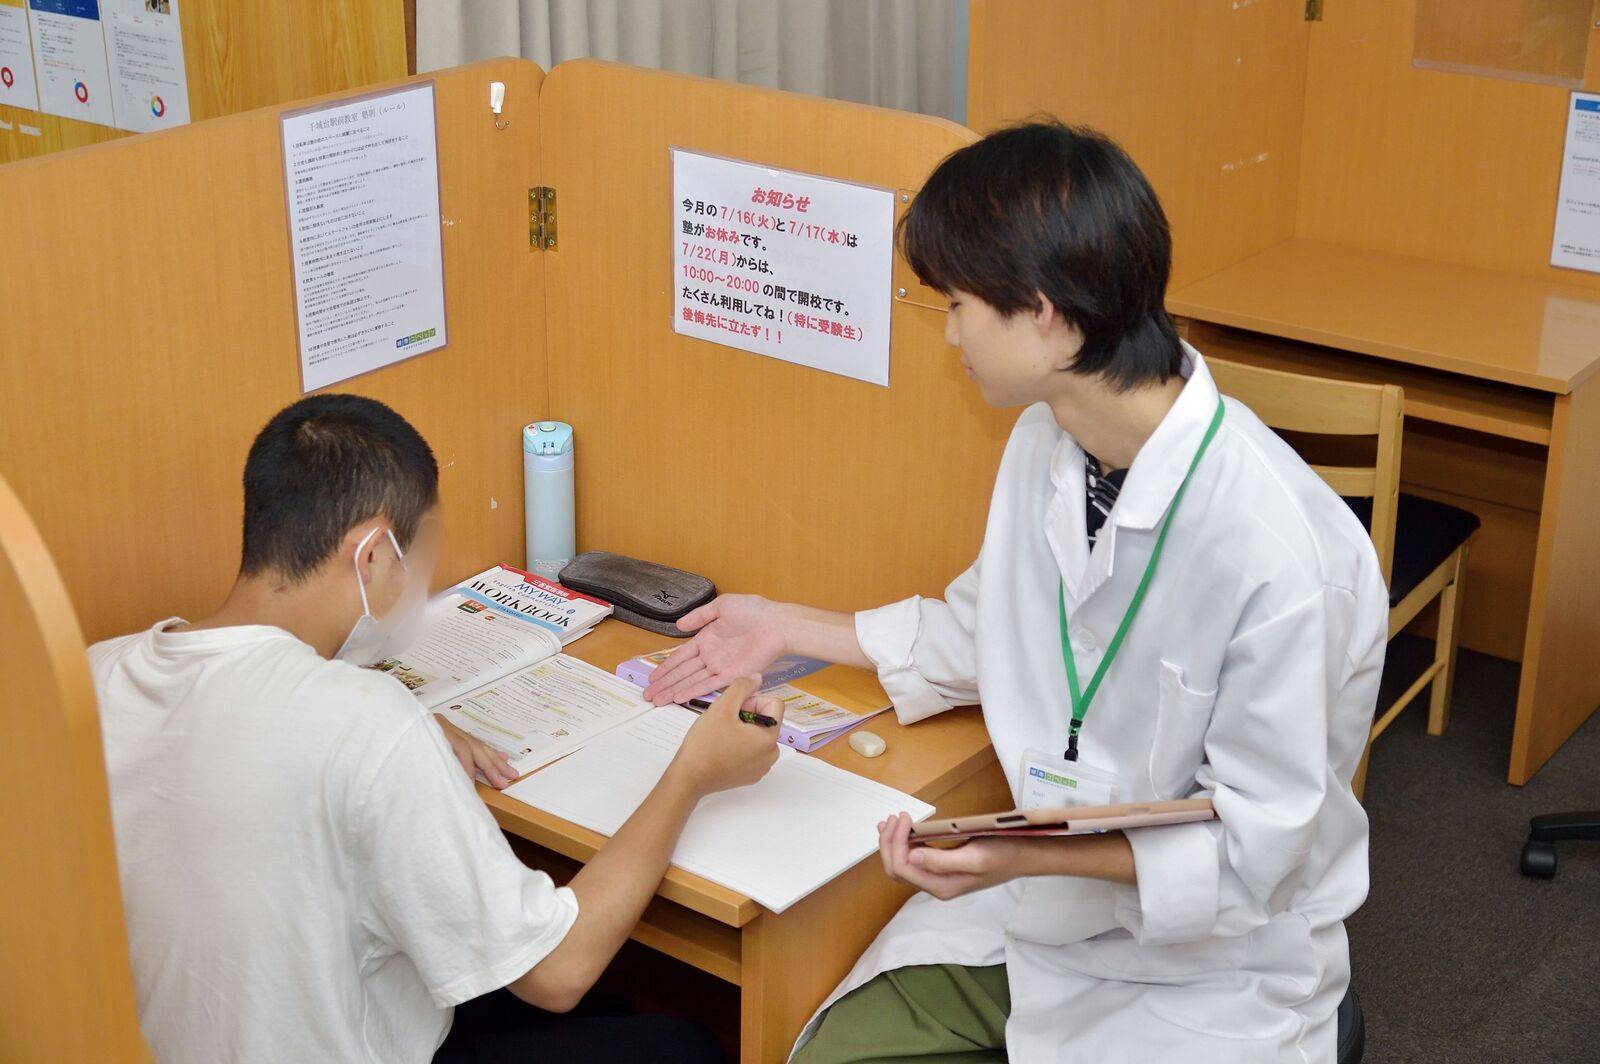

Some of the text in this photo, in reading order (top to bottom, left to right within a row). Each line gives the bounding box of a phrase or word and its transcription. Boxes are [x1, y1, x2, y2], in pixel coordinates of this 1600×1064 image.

[751, 187, 811, 213] お知らせ
[682, 220, 767, 251] 塾がお休みです。
[682, 242, 774, 276] 7/22(月)からは、
[682, 307, 782, 344] 後悔先に立たず!!
[470, 581, 570, 627] WORKBOOK
[514, 583, 540, 595] MY
[538, 591, 568, 605] WAY
